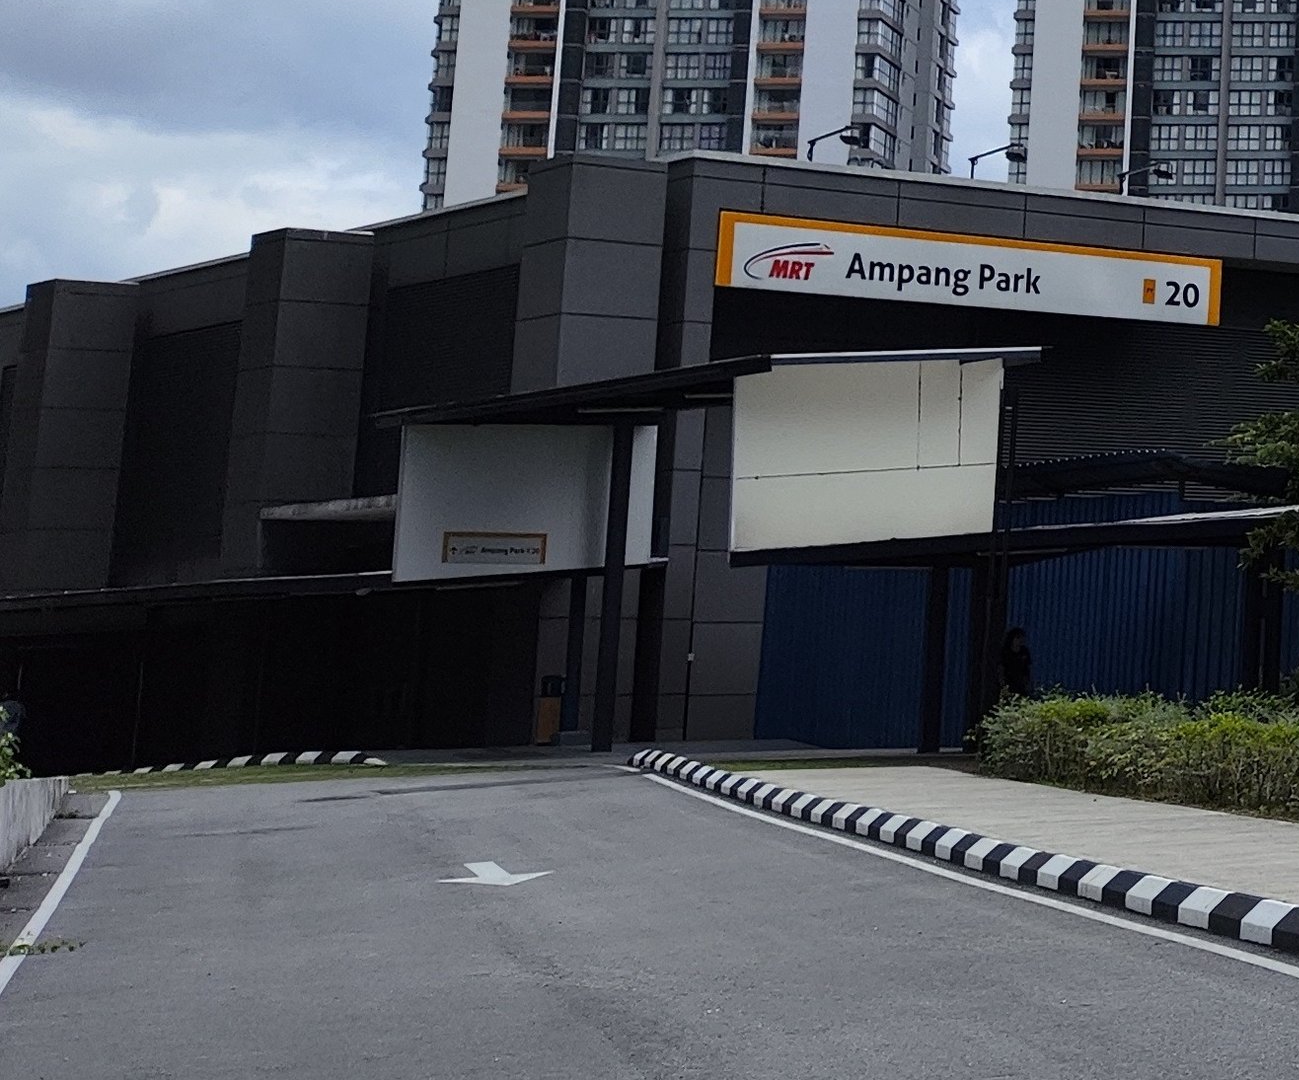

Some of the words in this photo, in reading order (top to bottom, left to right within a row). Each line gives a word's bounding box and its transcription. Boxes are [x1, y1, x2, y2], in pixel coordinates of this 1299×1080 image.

[768, 259, 815, 281] MRT
[845, 252, 971, 297] Ampang
[978, 263, 1041, 295] Park
[1164, 281, 1200, 308] 20
